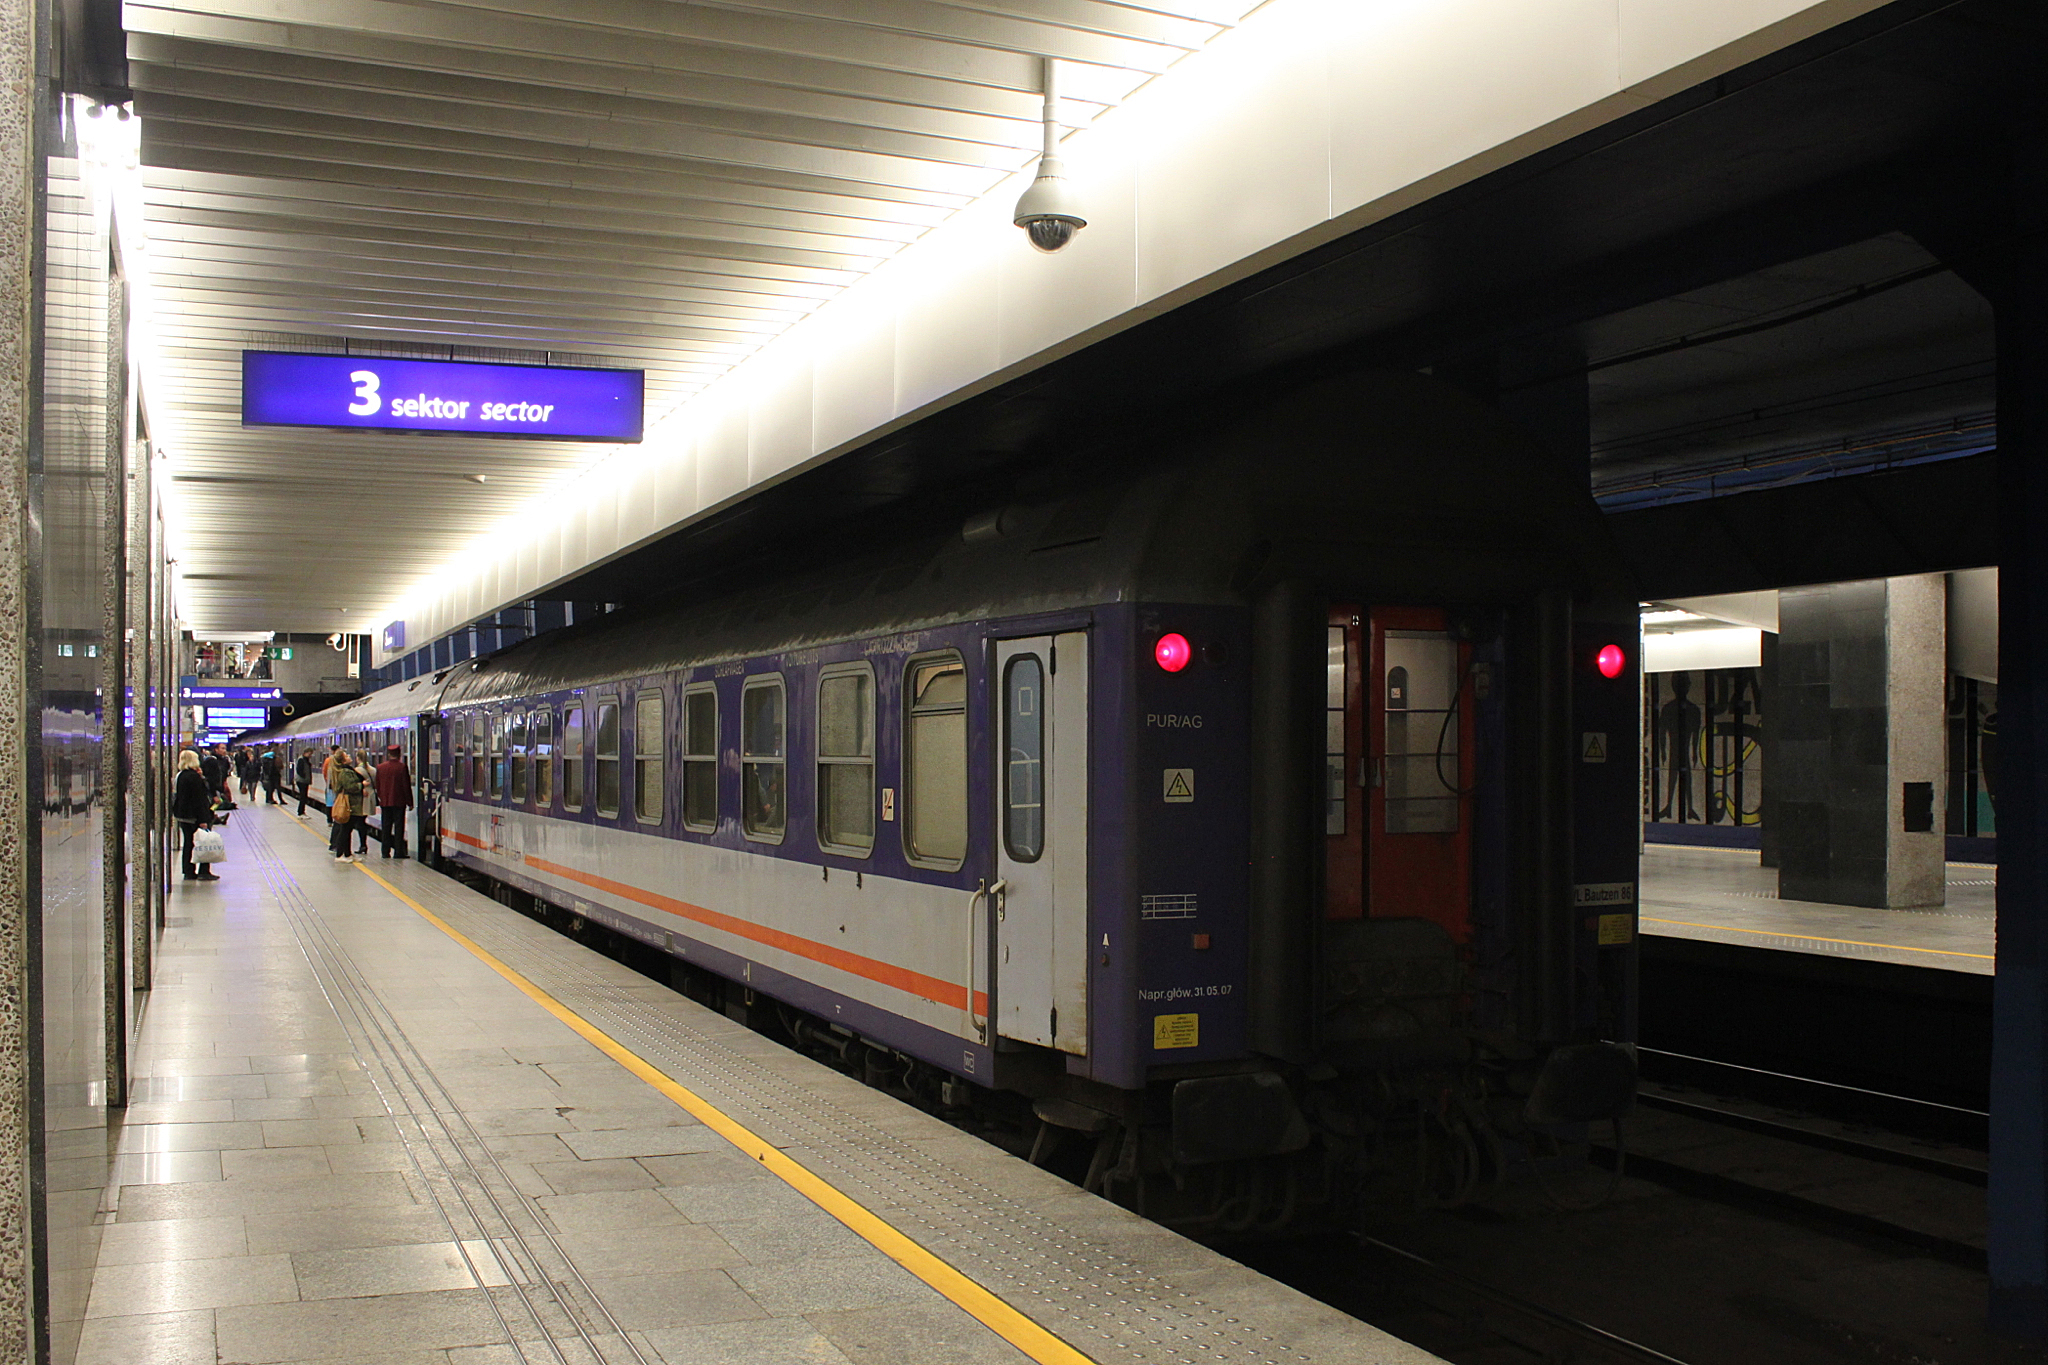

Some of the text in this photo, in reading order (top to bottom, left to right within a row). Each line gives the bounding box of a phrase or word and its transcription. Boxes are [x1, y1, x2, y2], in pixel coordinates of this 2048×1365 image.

[348, 370, 554, 423] 3 sektor sector
[183, 687, 191, 698] 3
[272, 688, 281, 699] 4
[1147, 713, 1203, 729] PUR/AG
[1584, 888, 1619, 902] Bautzen
[1621, 886, 1632, 900] 86
